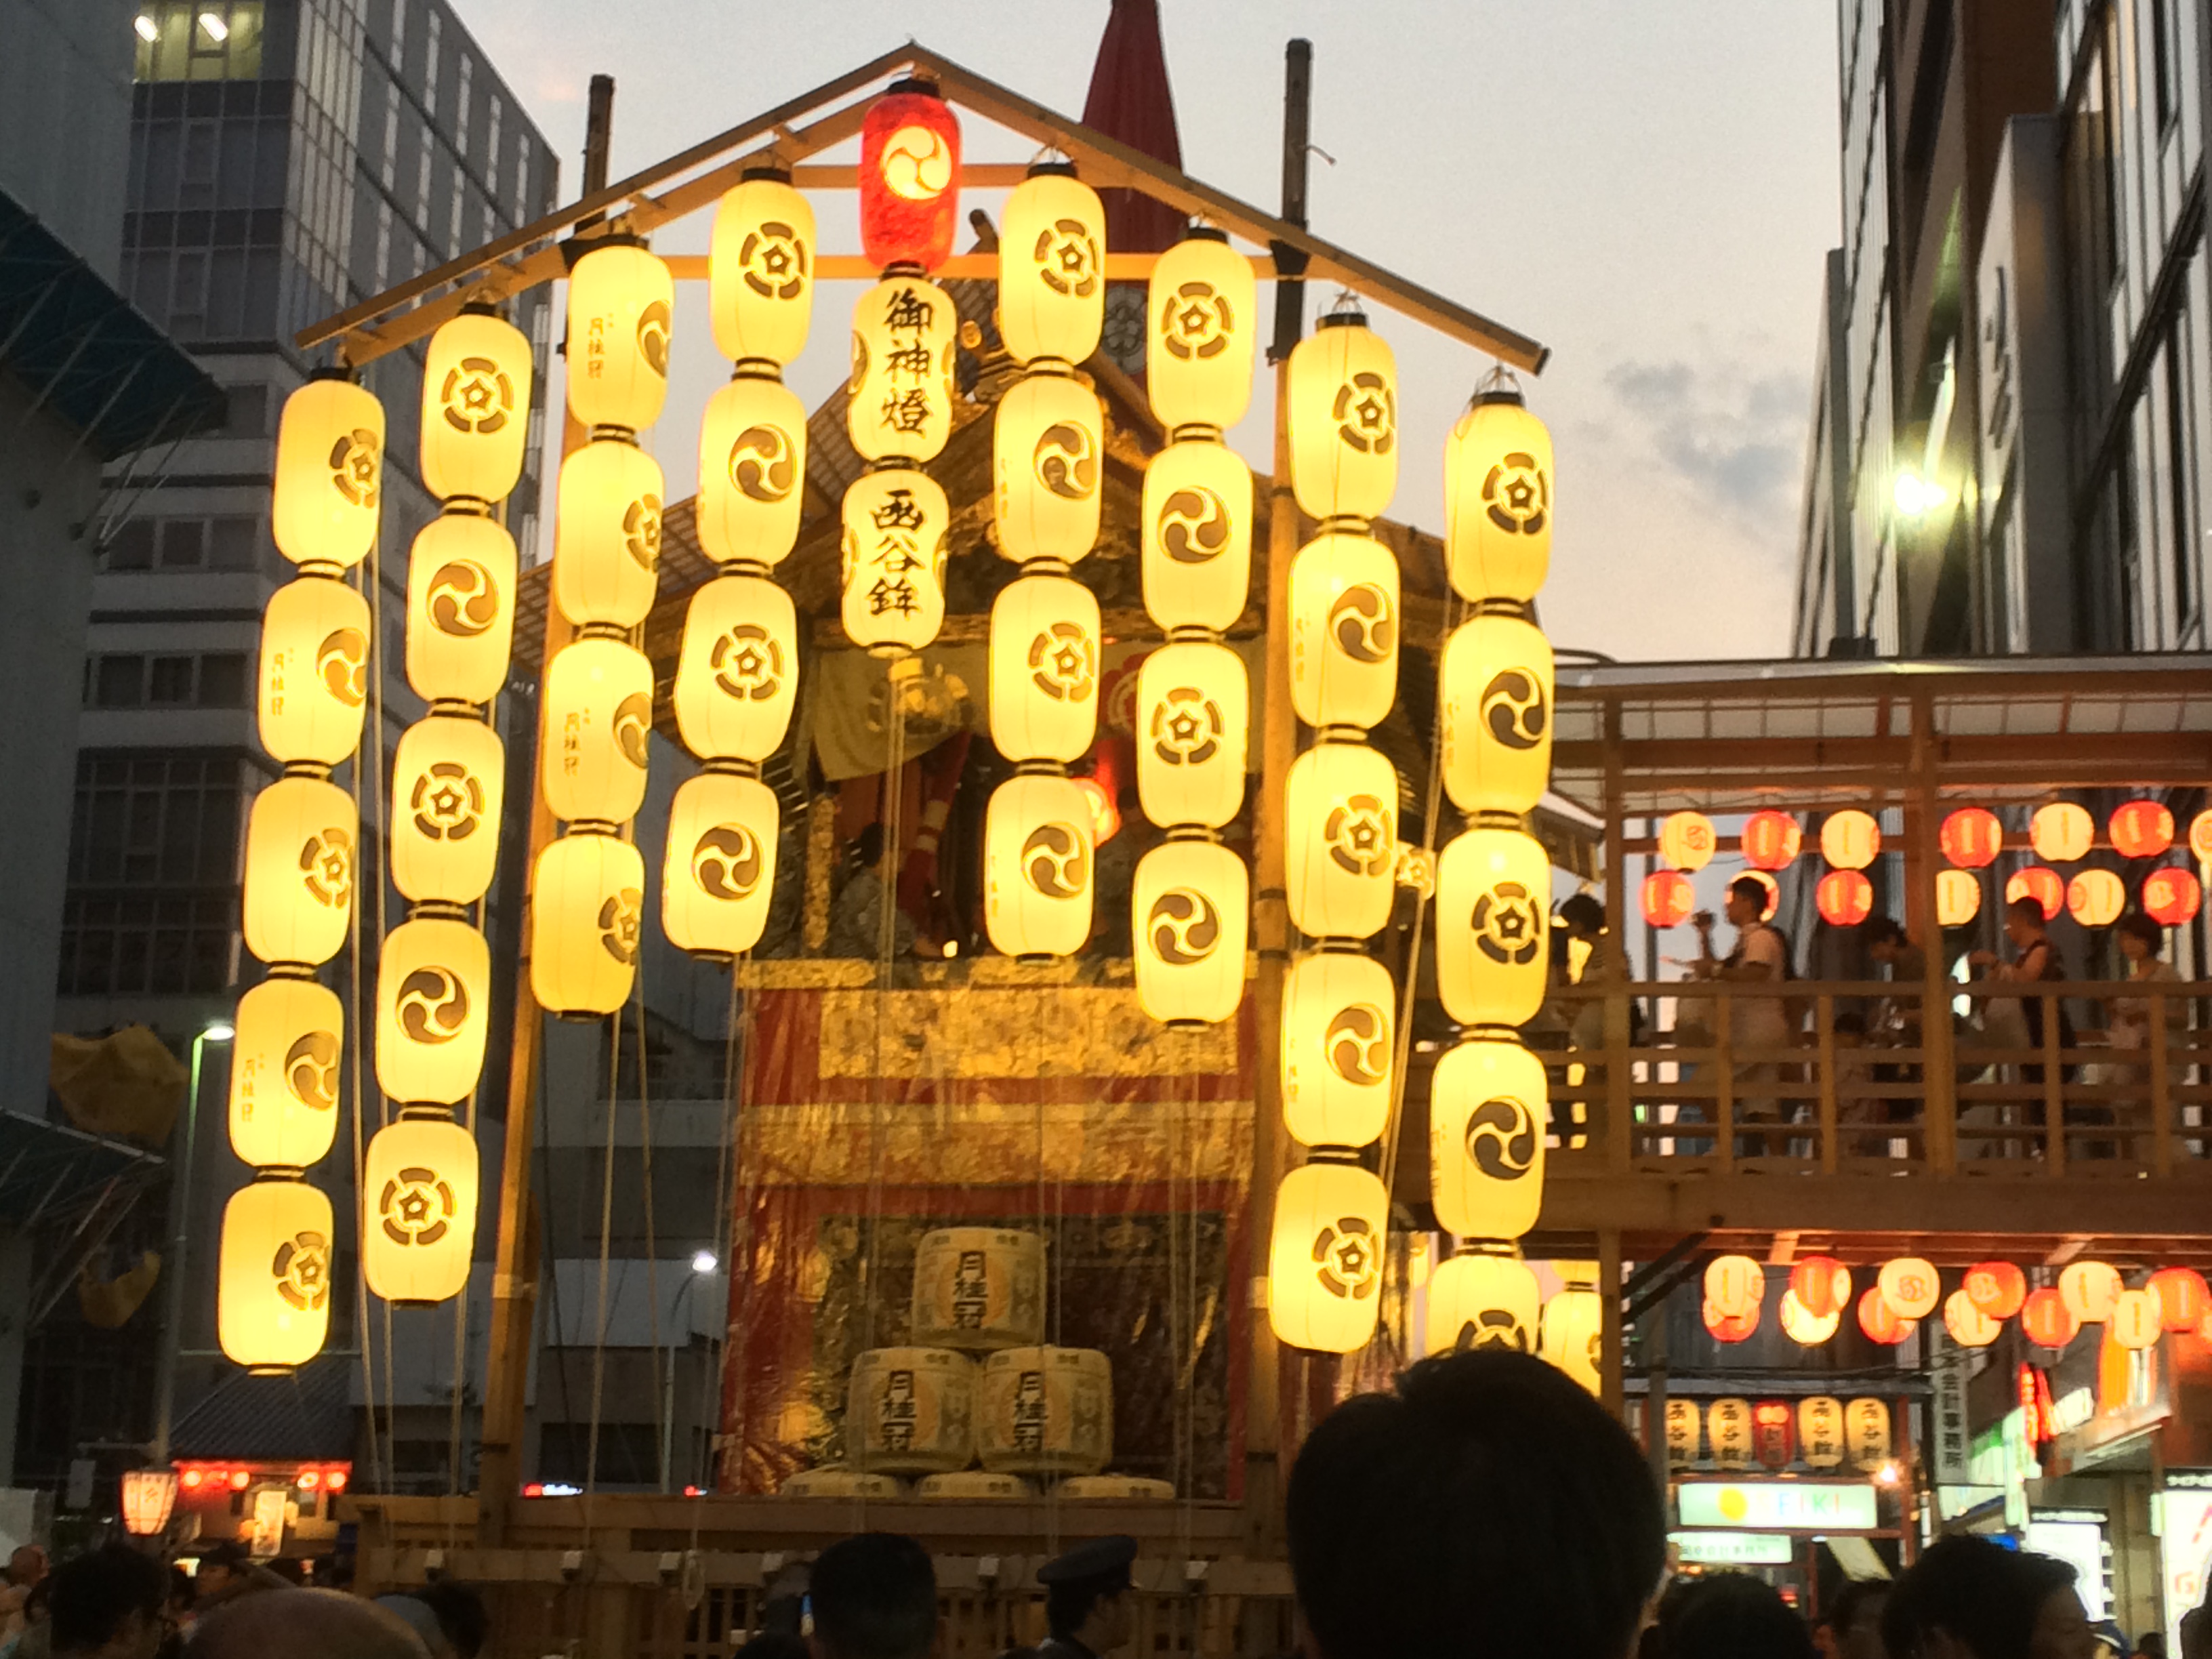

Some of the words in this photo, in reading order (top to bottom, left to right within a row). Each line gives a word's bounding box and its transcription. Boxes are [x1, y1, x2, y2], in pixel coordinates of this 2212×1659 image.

[882, 288, 932, 436] 御神燈
[953, 1251, 988, 1329] 月桂冠
[881, 1370, 917, 1451] 月桂冠
[1014, 1370, 1048, 1451] 月桂冠
